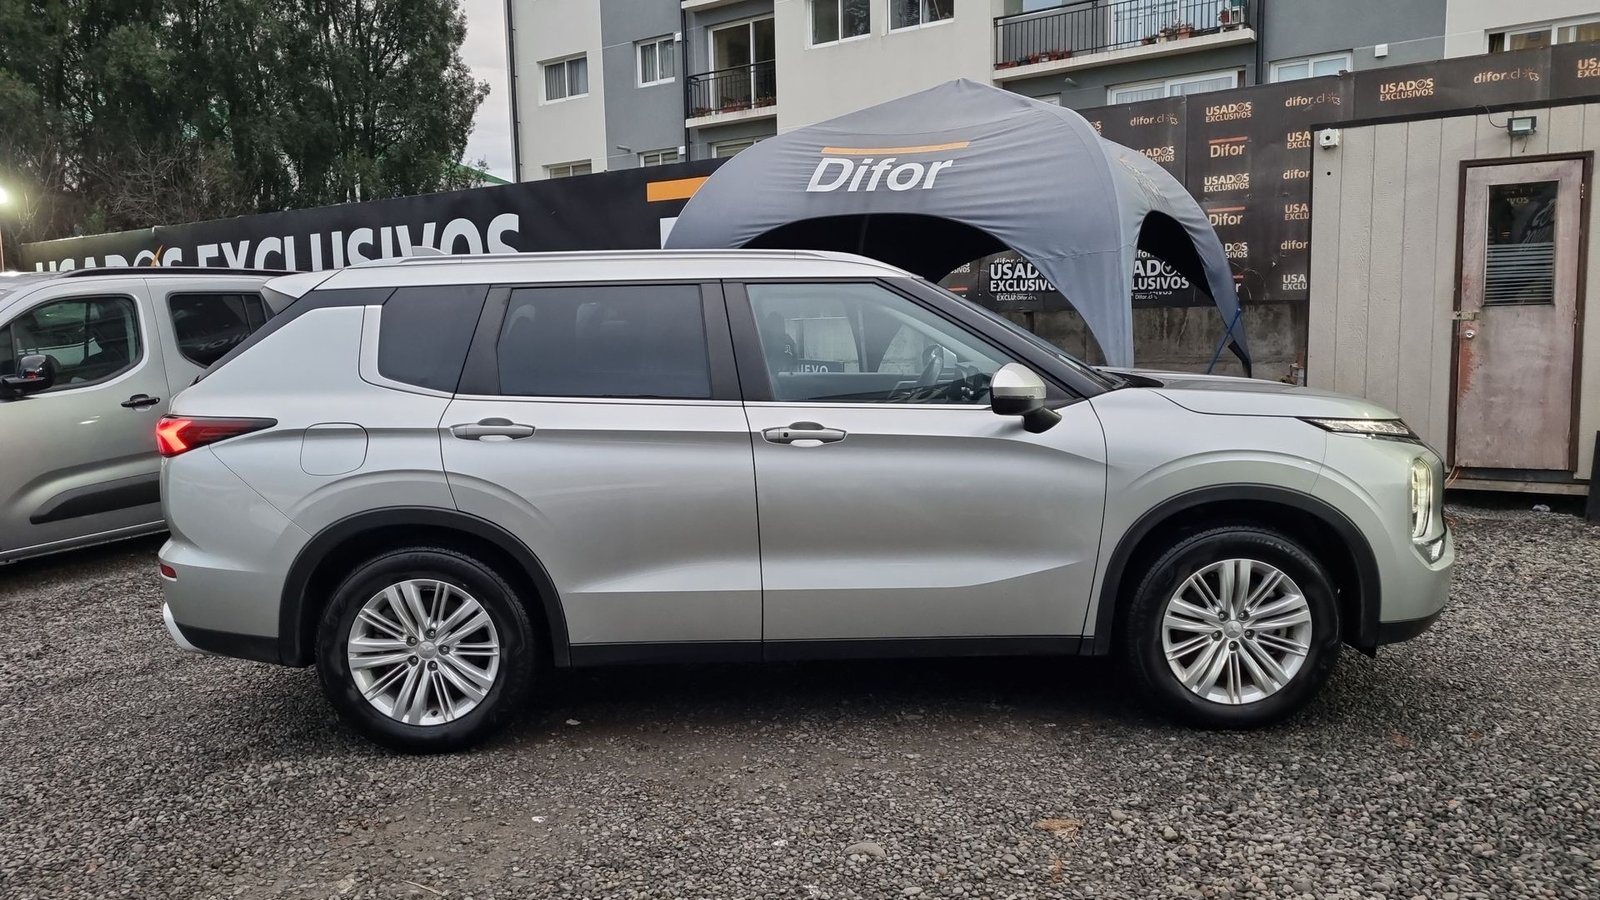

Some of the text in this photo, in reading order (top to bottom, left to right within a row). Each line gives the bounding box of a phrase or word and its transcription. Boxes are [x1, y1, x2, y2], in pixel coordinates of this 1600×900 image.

[1474, 68, 1520, 84] difor.cl
[1380, 78, 1434, 94] USADOS
[1285, 93, 1325, 107] difor.cl
[1380, 88, 1434, 101] EXCLUSIVOS
[1205, 102, 1251, 115] USADOS
[1130, 114, 1164, 126] difor.cl
[1205, 111, 1251, 123] EXCLUSIVOS
[1287, 131, 1311, 142] USA
[1136, 146, 1175, 157] SADOS
[1210, 144, 1245, 157] Difor
[806, 157, 953, 192] Difor
[1204, 173, 1249, 186] USADOS
[1283, 169, 1310, 180] difor
[1204, 182, 1249, 192] EXCLUSIVOS
[1285, 203, 1308, 214] USA
[1208, 213, 1243, 226] Difor
[1285, 212, 1310, 220] EXCLU
[1225, 242, 1248, 252] DOS
[1281, 240, 1308, 250] difor
[1226, 251, 1248, 259] SIVOS
[990, 263, 1040, 279] USAD
[990, 279, 1056, 291] EXCLUSIV
[1132, 276, 1190, 290] LUSIVOS
[1282, 274, 1307, 284] USA
